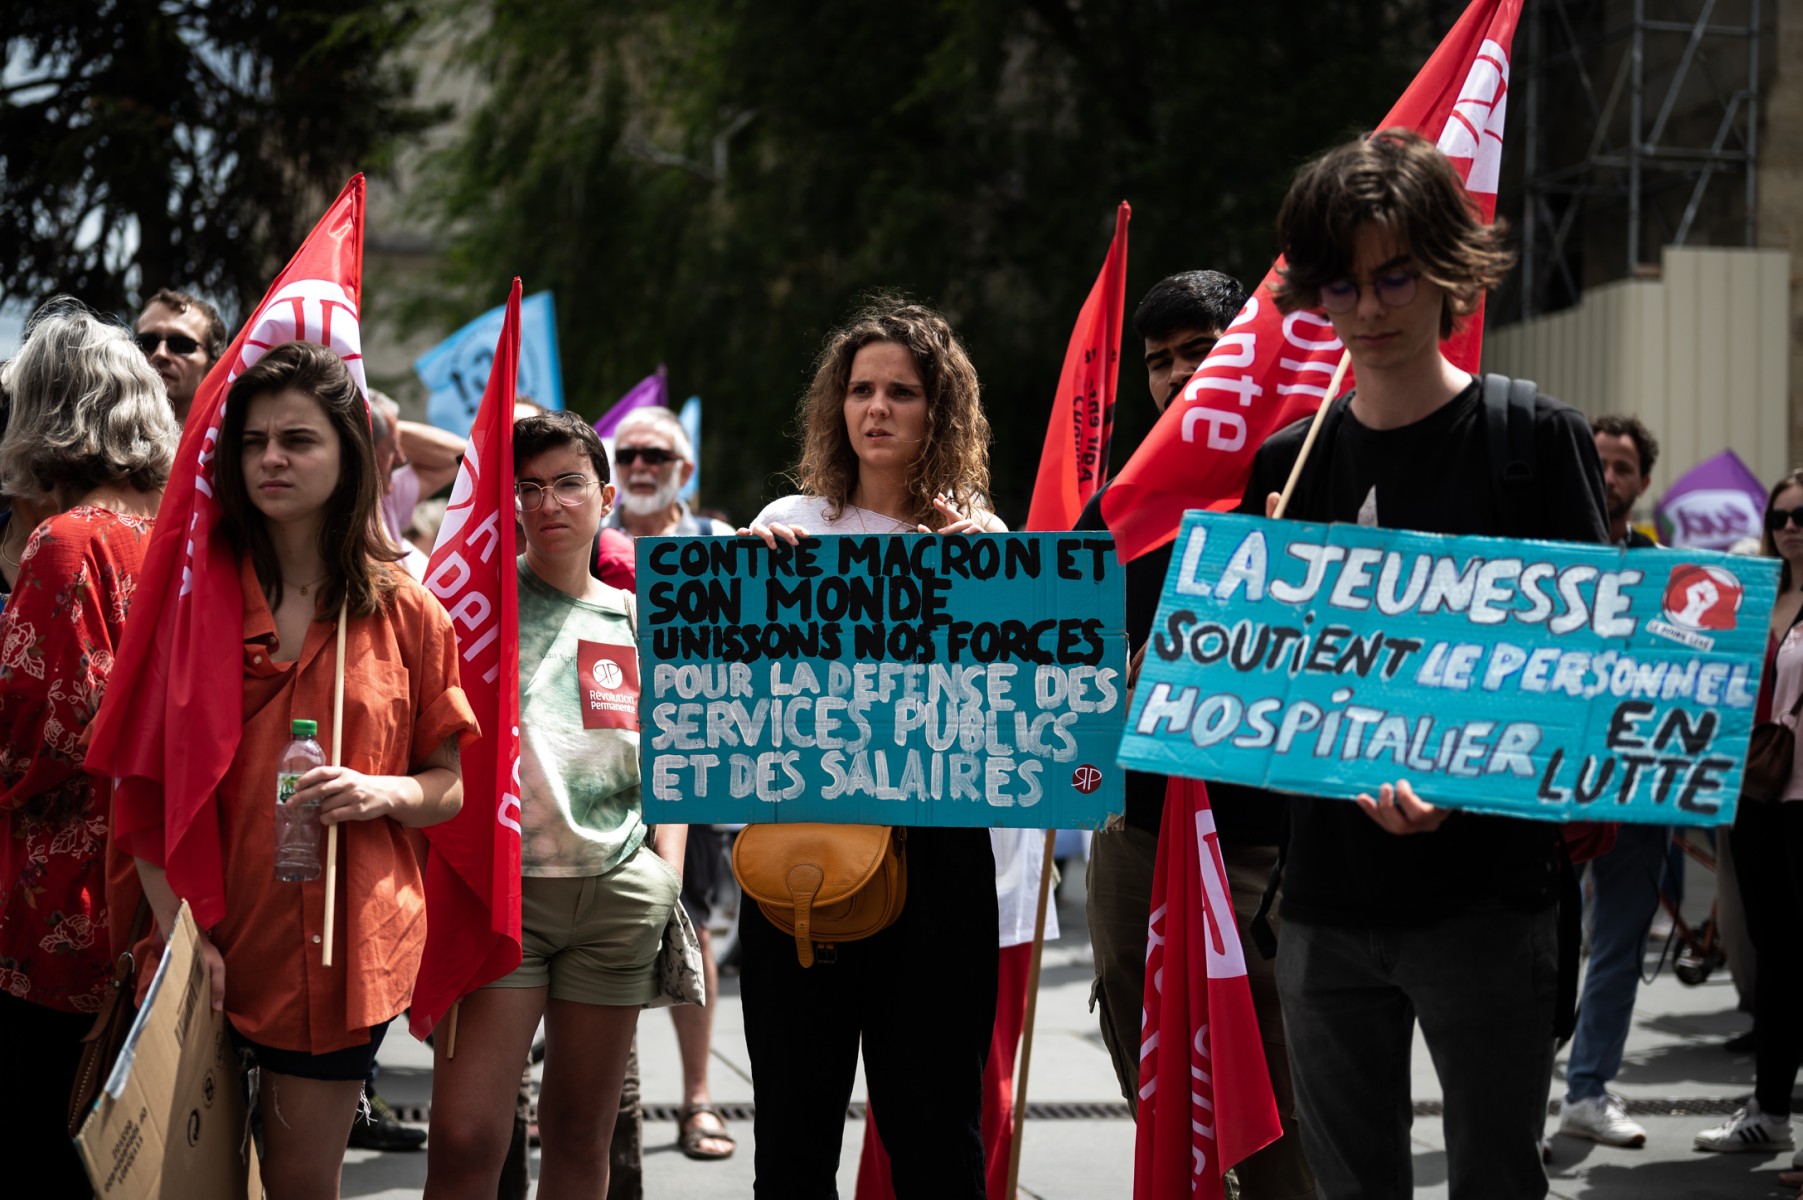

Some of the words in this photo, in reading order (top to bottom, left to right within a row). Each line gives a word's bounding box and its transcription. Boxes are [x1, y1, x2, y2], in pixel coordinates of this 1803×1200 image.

[648, 537, 823, 578] CONTRE
[837, 536, 1041, 580] MACRON
[1057, 537, 1116, 583] ET
[1175, 524, 1267, 603] LA
[1268, 540, 1646, 639] JEUNESSE
[648, 576, 742, 625] SON
[765, 573, 954, 627] MONDE
[651, 620, 843, 663] UNISSONS
[853, 621, 937, 664] NOS
[947, 617, 1105, 666] FORCES
[589, 690, 635, 705] Révolution
[653, 663, 754, 700] POUR
[770, 661, 821, 697] LA
[827, 661, 1018, 712] DEFENSE
[1034, 663, 1118, 714] DES
[1415, 641, 1485, 690] LE
[1480, 641, 1756, 708] PERSONNEL
[590, 700, 636, 714] Permanente
[651, 697, 872, 754] SERVICES
[894, 699, 1079, 763] PUBLICS
[1606, 699, 1721, 756] EN
[652, 753, 720, 801] ET
[729, 749, 805, 802] DES
[820, 749, 1044, 808] SALAIRES
[1536, 748, 1736, 815] LUTTE
